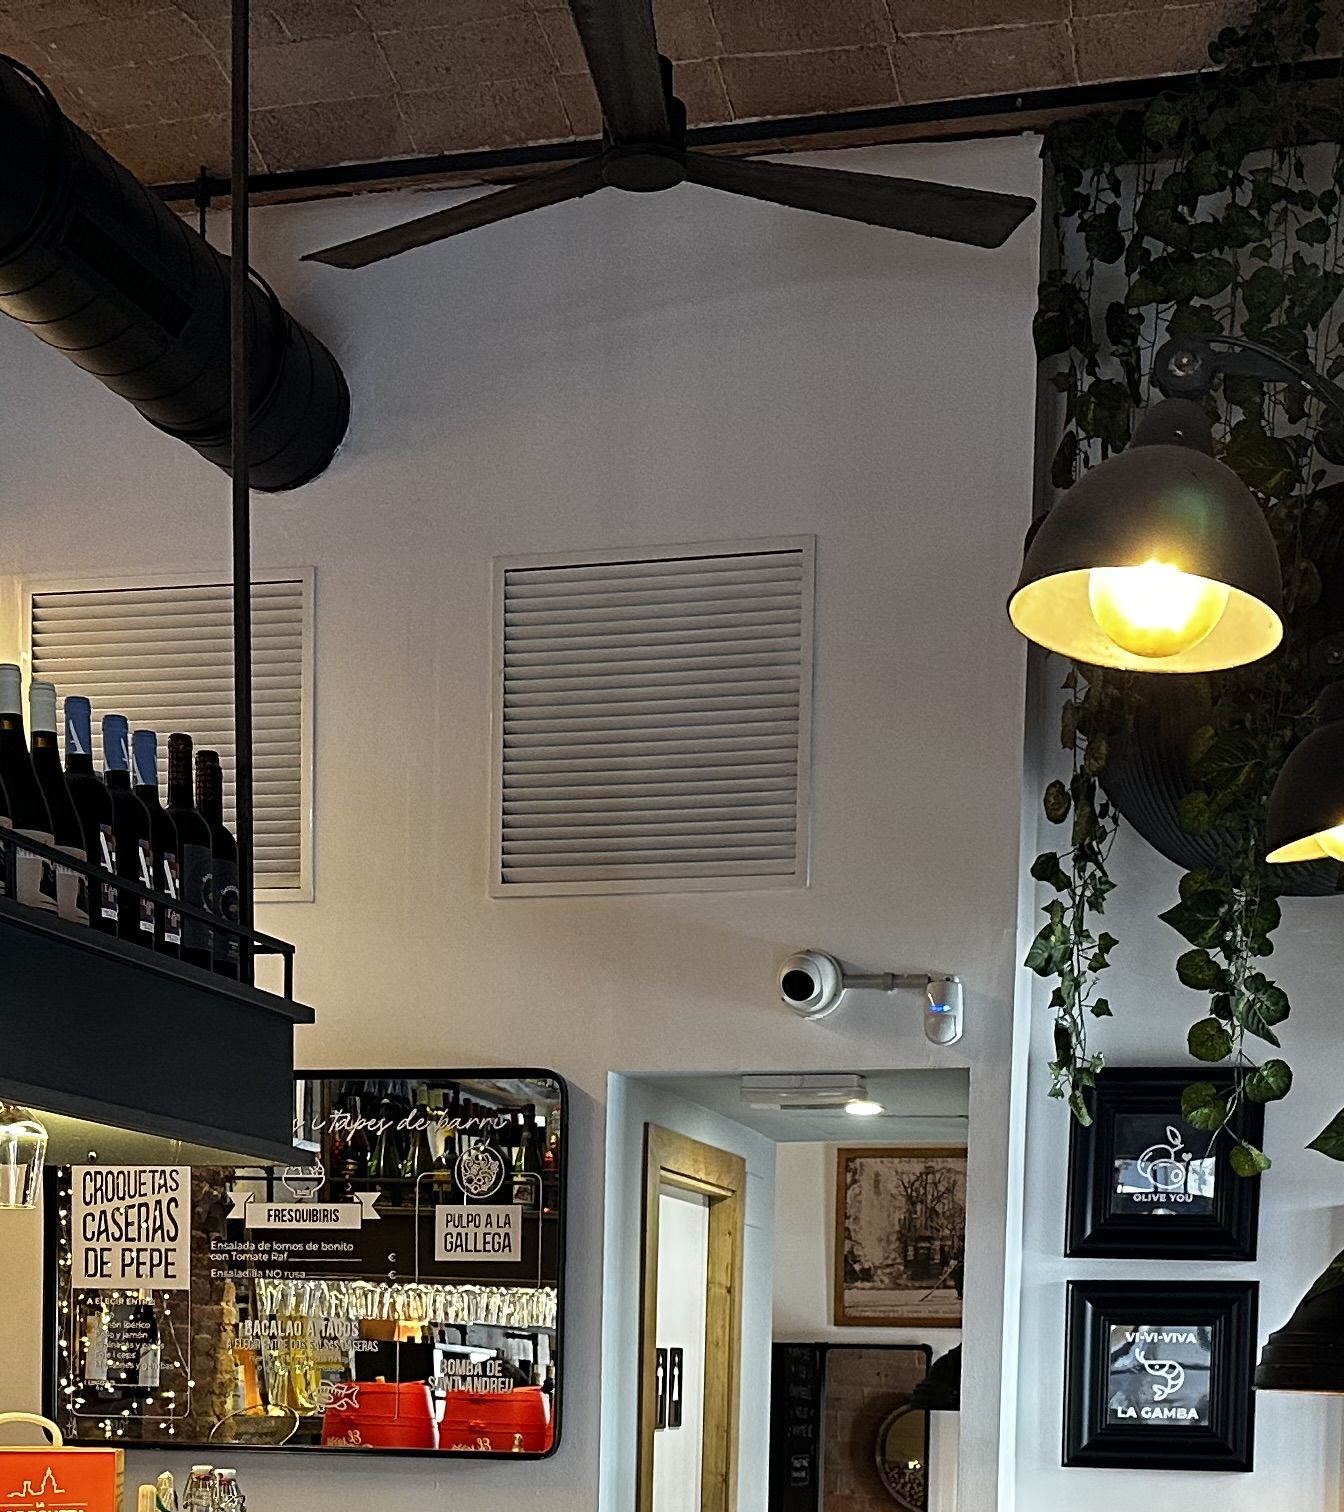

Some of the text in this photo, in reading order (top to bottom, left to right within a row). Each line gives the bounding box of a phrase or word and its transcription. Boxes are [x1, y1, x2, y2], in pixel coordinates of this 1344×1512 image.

[397, 1108, 431, 1131] de
[82, 1169, 179, 1206] CROQUETAS
[1133, 1193, 1194, 1203] OLIVE YOU
[82, 1197, 179, 1242] CASERAS
[267, 1208, 340, 1223] FRESQUIBIRIS
[445, 1213, 512, 1228] PULPO A LA
[211, 1241, 354, 1251] Ensalada de lomos de bonito
[444, 1232, 512, 1253] GALLEGA
[84, 1247, 177, 1278] DE PEPE
[210, 1252, 397, 1262] con Tomate Raf €
[265, 1270, 282, 1279] NO
[284, 1271, 306, 1279] rusa
[388, 1271, 397, 1280] €
[244, 1320, 359, 1337] BACALAO A TACOS
[1125, 1331, 1196, 1344] VI-VI-VIVA
[440, 1358, 503, 1376] BOMBA DE
[1117, 1406, 1199, 1420] LA GAMBA
